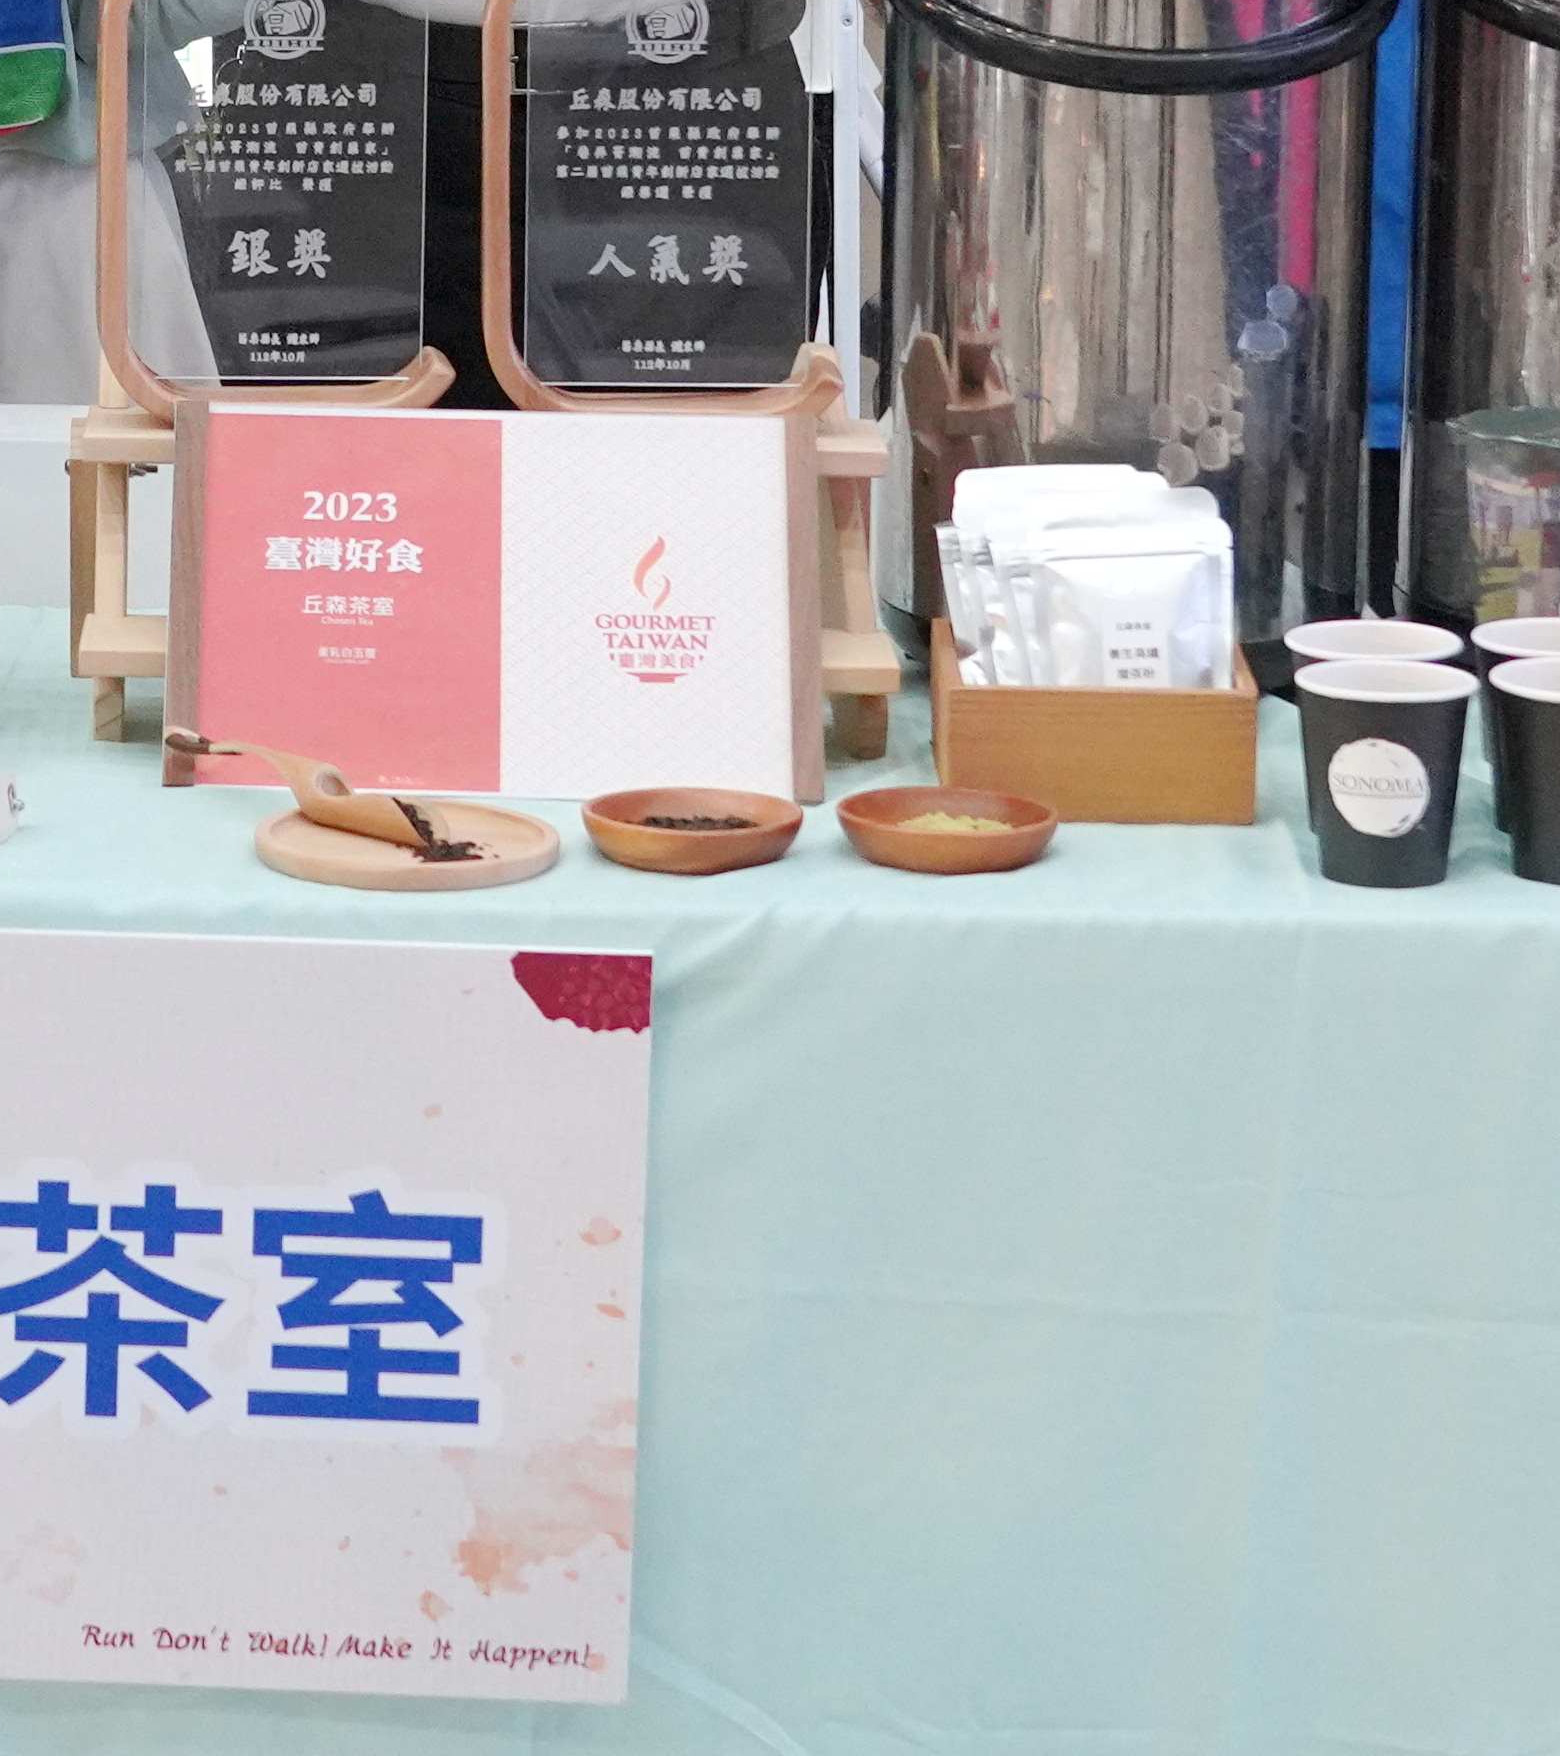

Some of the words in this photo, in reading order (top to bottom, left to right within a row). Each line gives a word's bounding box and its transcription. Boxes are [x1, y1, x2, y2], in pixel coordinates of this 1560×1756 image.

[303, 490, 399, 523] 2023
[264, 536, 424, 574] 臺灣好食
[302, 594, 396, 617] 丘森茶室
[595, 613, 717, 631] GOURMET
[602, 632, 709, 650] TAIWAN
[81, 1624, 136, 1648] Run
[152, 1625, 231, 1653] Don't
[247, 1630, 328, 1658] Walk!
[336, 1637, 413, 1660] Make
[429, 1638, 452, 1662] It
[469, 1640, 593, 1671] Happen!
